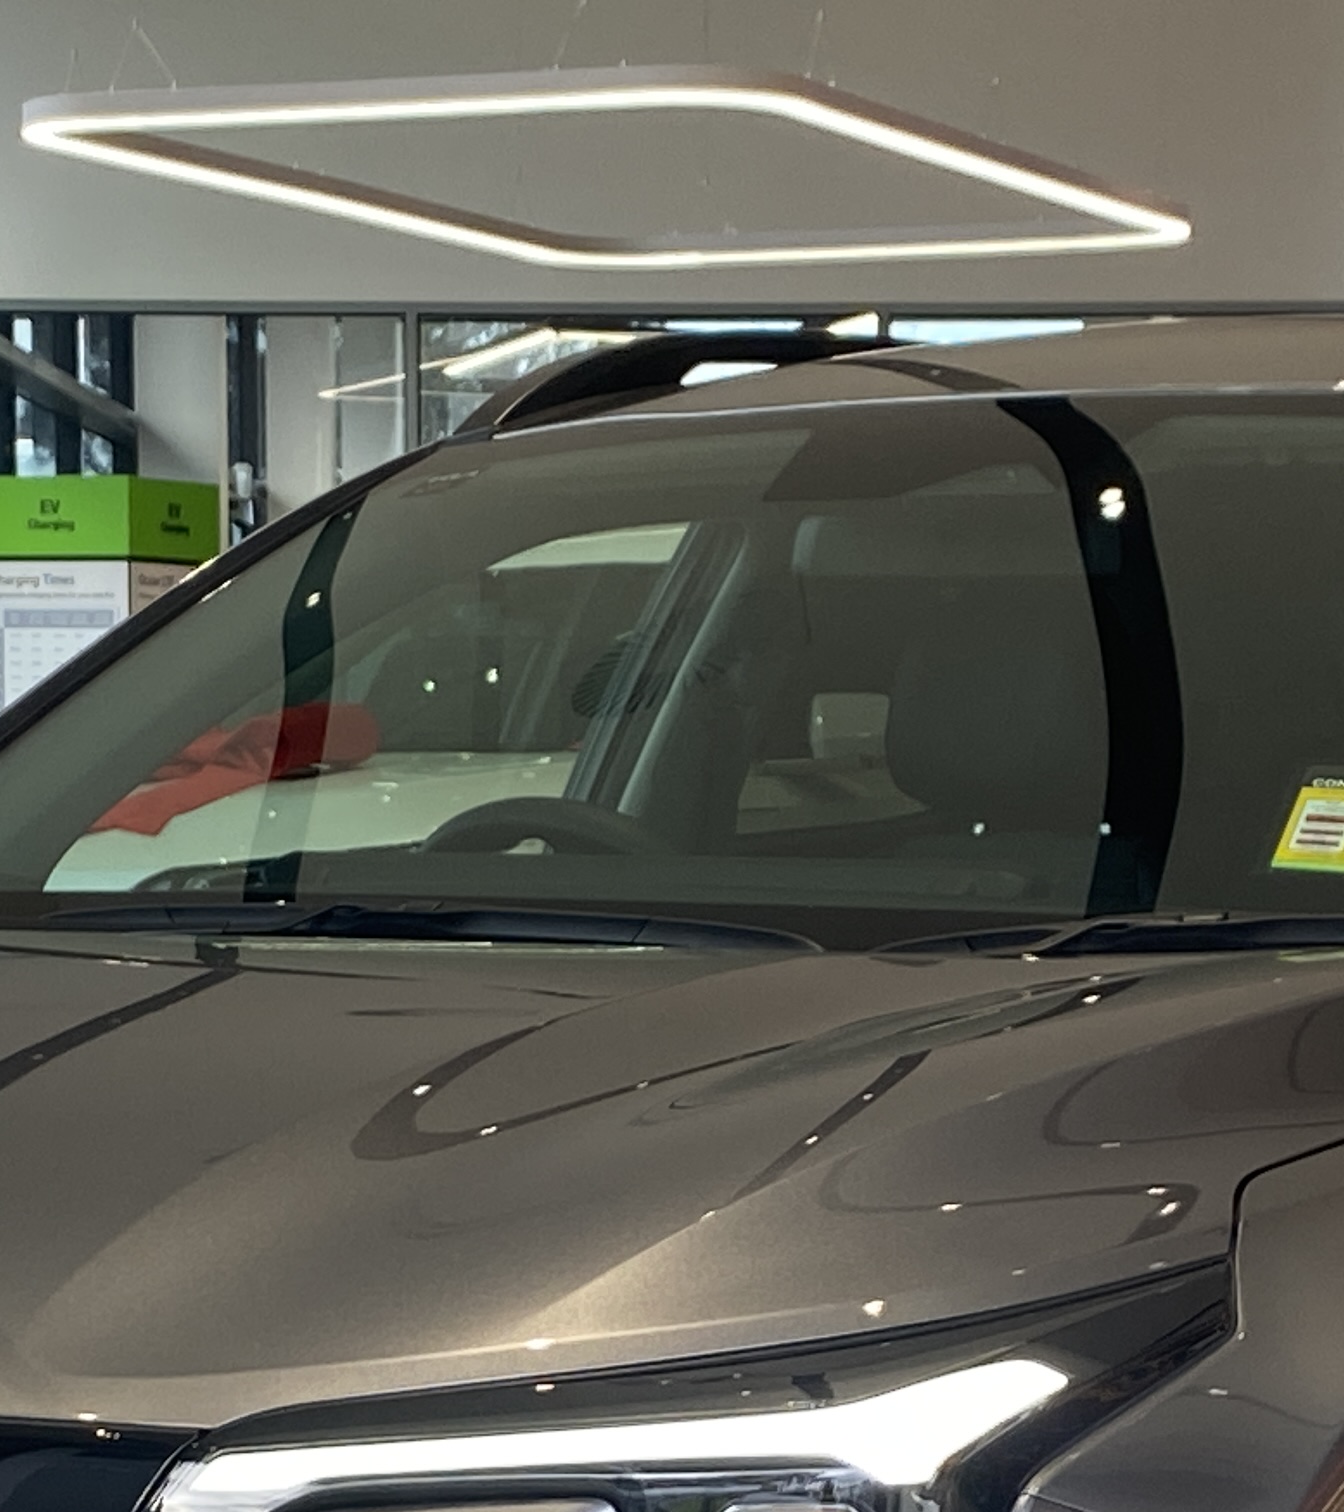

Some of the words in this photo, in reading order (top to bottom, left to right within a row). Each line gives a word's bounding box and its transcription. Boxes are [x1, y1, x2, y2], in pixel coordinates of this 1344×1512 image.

[40, 499, 60, 514] EV
[27, 518, 76, 532] Charging
[43, 573, 76, 586] Times
